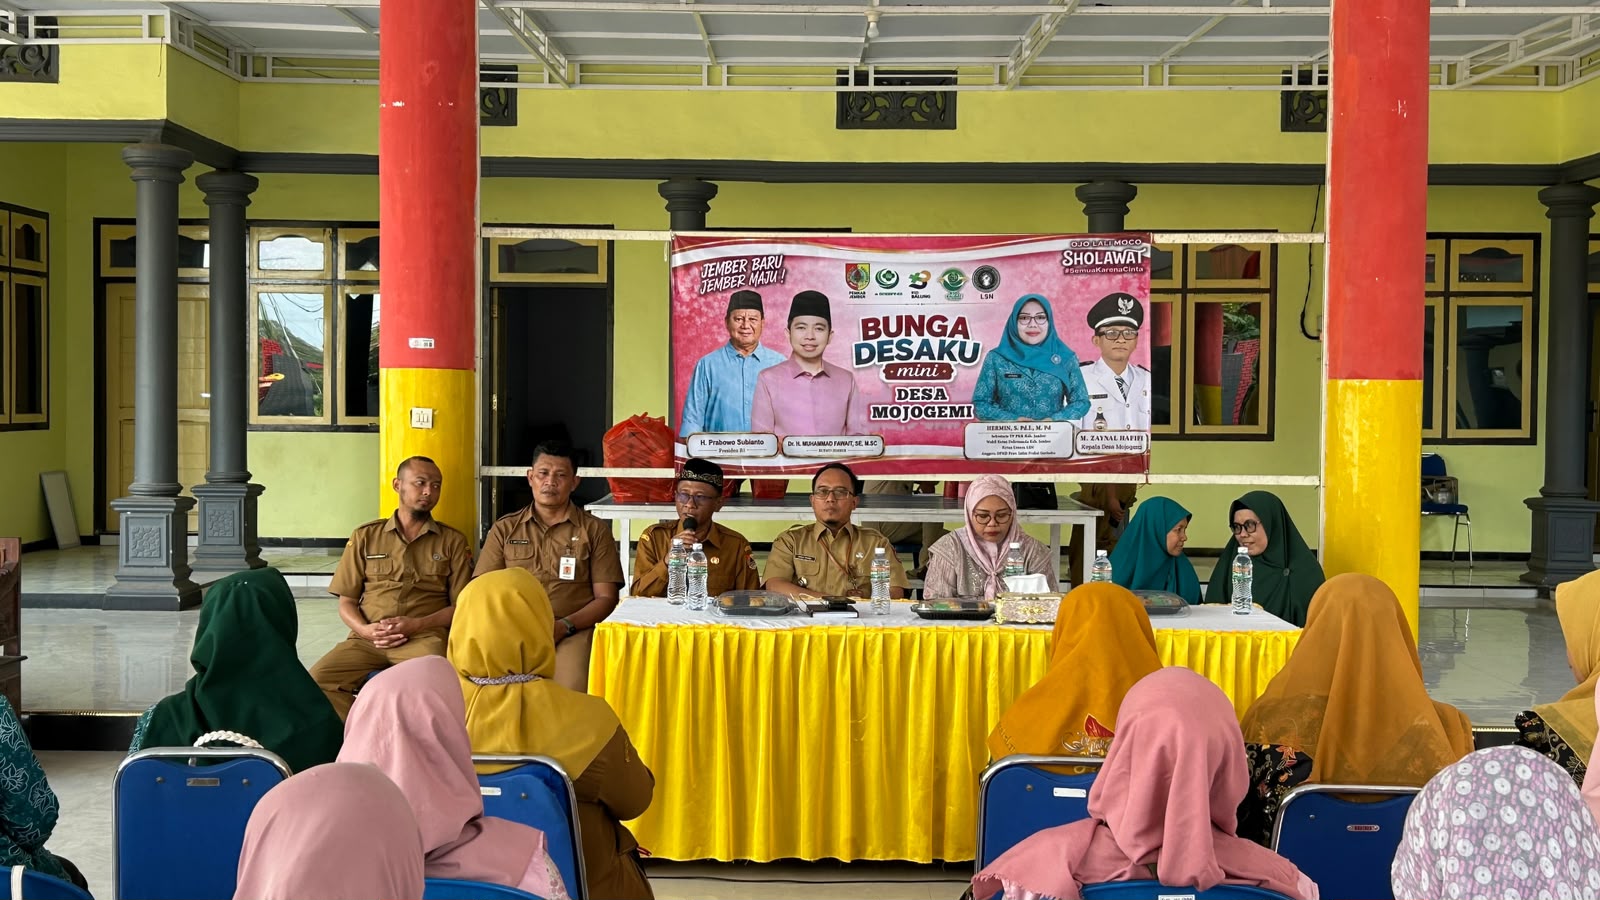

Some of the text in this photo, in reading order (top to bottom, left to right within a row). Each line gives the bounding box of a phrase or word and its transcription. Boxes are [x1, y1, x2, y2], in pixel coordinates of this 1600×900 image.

[1071, 240, 1090, 248] OJO
[1062, 248, 1147, 267] SHOLAWAT
[701, 254, 784, 279] JEMBER BARU
[1064, 266, 1144, 274] #SemuaKarenaCinta
[700, 274, 746, 295] JEMBER
[749, 270, 778, 288] MAJU
[861, 314, 970, 341] BUNGA
[854, 338, 981, 366] DESAKU
[897, 364, 940, 377] mini
[896, 388, 948, 401] DESA
[872, 405, 973, 421] MOJOGEMI
